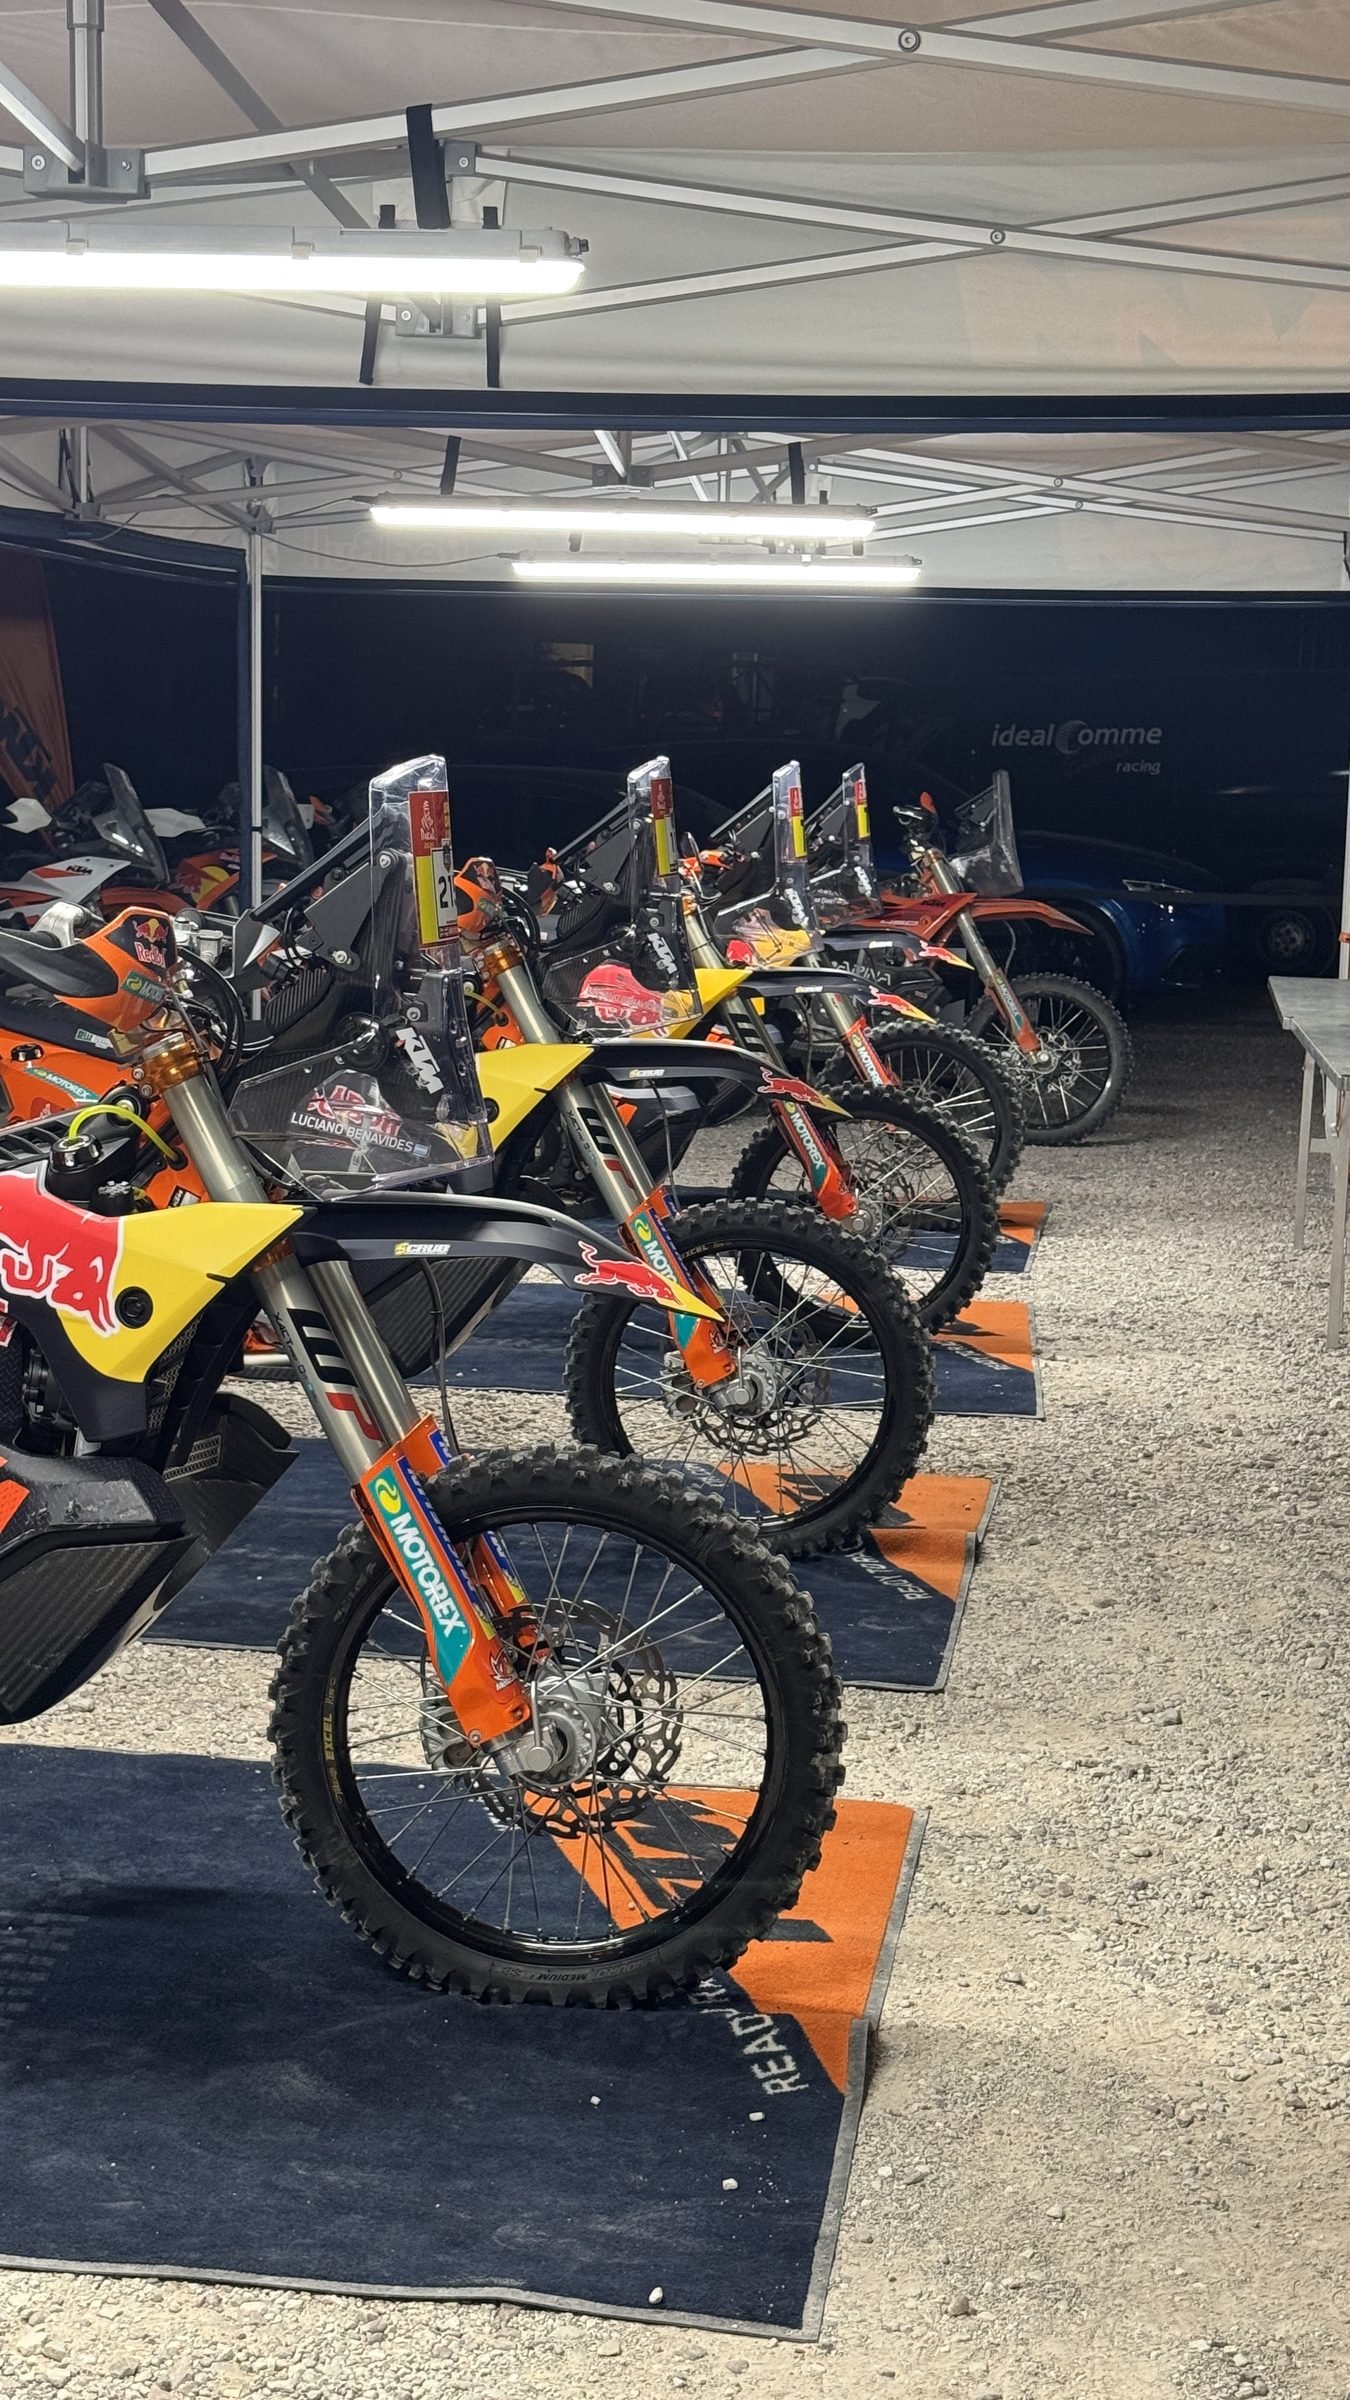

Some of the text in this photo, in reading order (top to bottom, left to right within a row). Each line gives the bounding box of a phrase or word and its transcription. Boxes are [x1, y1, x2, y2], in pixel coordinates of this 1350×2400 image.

[1116, 760, 1161, 775] racing
[66, 865, 93, 876] KTM
[646, 932, 678, 975] KTM
[396, 1027, 444, 1094] KTM
[856, 1046, 885, 1088] MOTORE
[45, 1074, 90, 1099] MOTOREX
[290, 1112, 414, 1152] LUCIANO BENAVIDES
[790, 1112, 826, 1170] MOTOREX
[644, 1240, 678, 1283] MOTO
[389, 1511, 467, 1638] MOTOREX
[322, 1713, 335, 1762] EXCEL
[536, 1971, 589, 1982] MEDIUM
